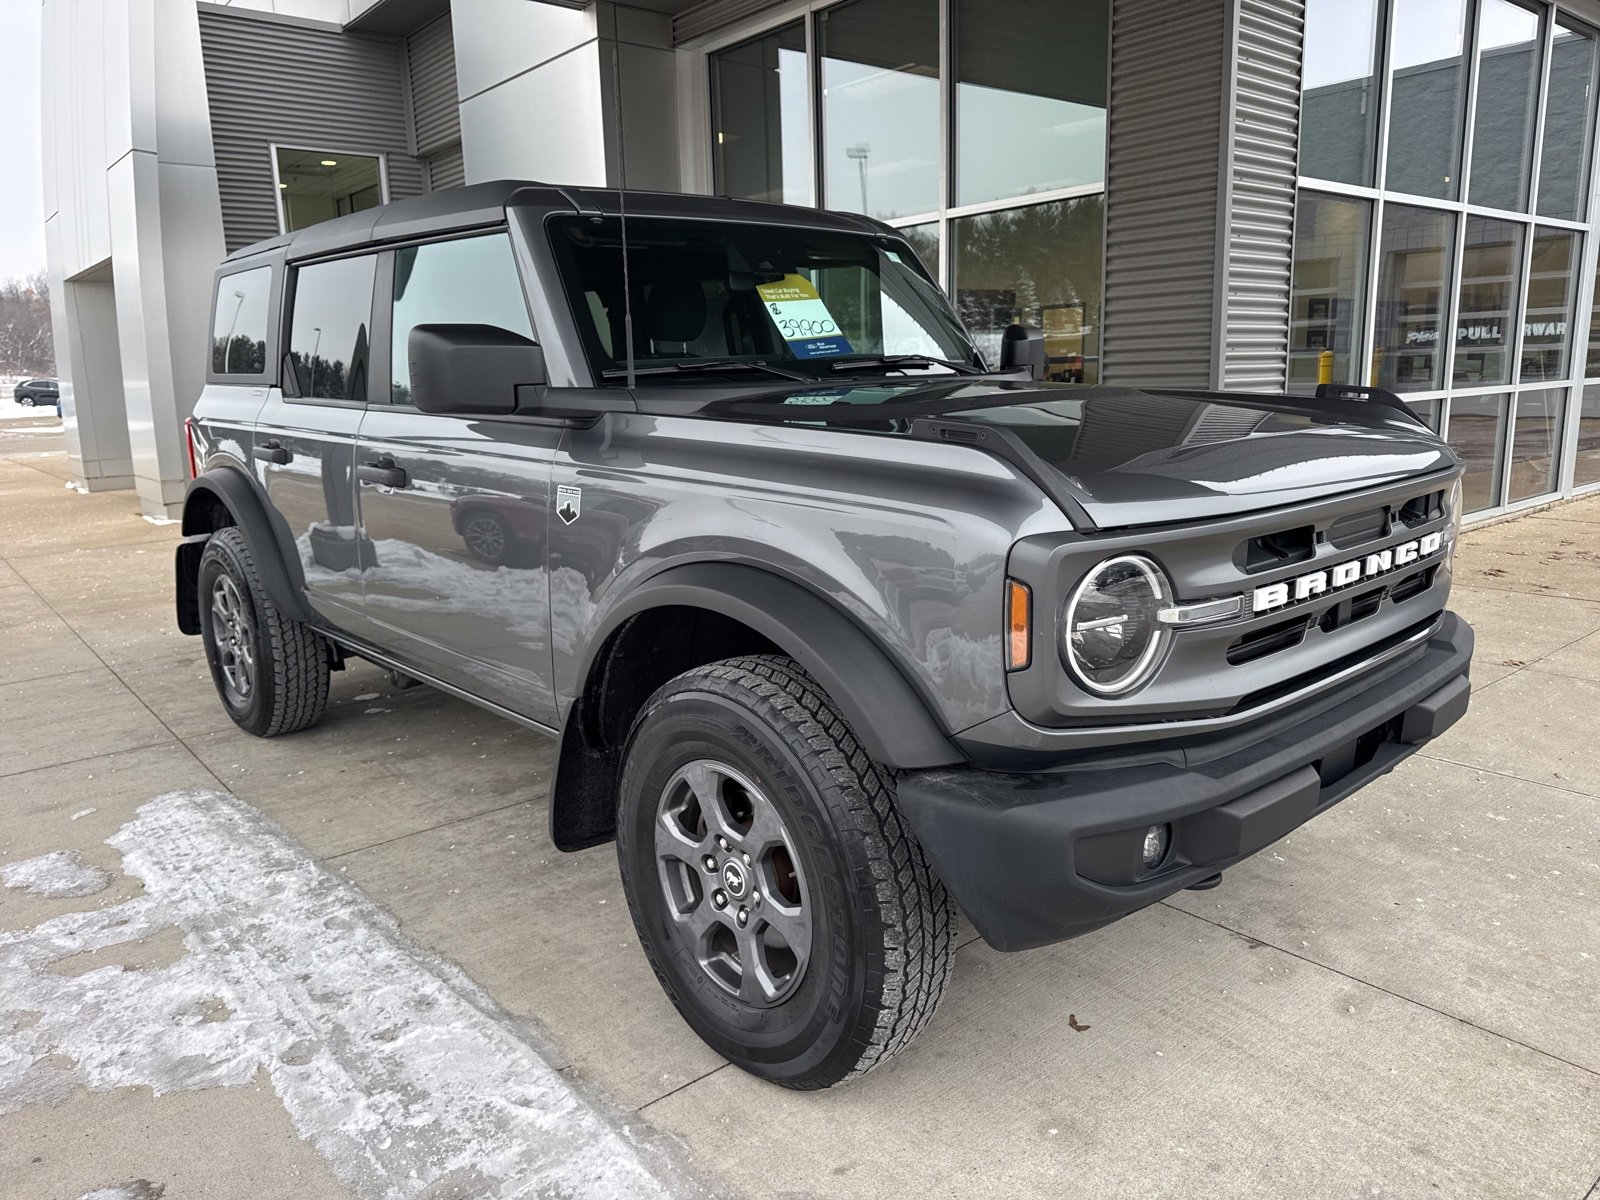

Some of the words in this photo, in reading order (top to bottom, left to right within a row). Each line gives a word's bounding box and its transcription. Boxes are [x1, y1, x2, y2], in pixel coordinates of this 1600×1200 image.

[1458, 325, 1501, 340] PULL
[1524, 322, 1567, 337] RWAR
[1253, 531, 1443, 612] BRONCO
[730, 725, 851, 1025] BRIDGESTONE
